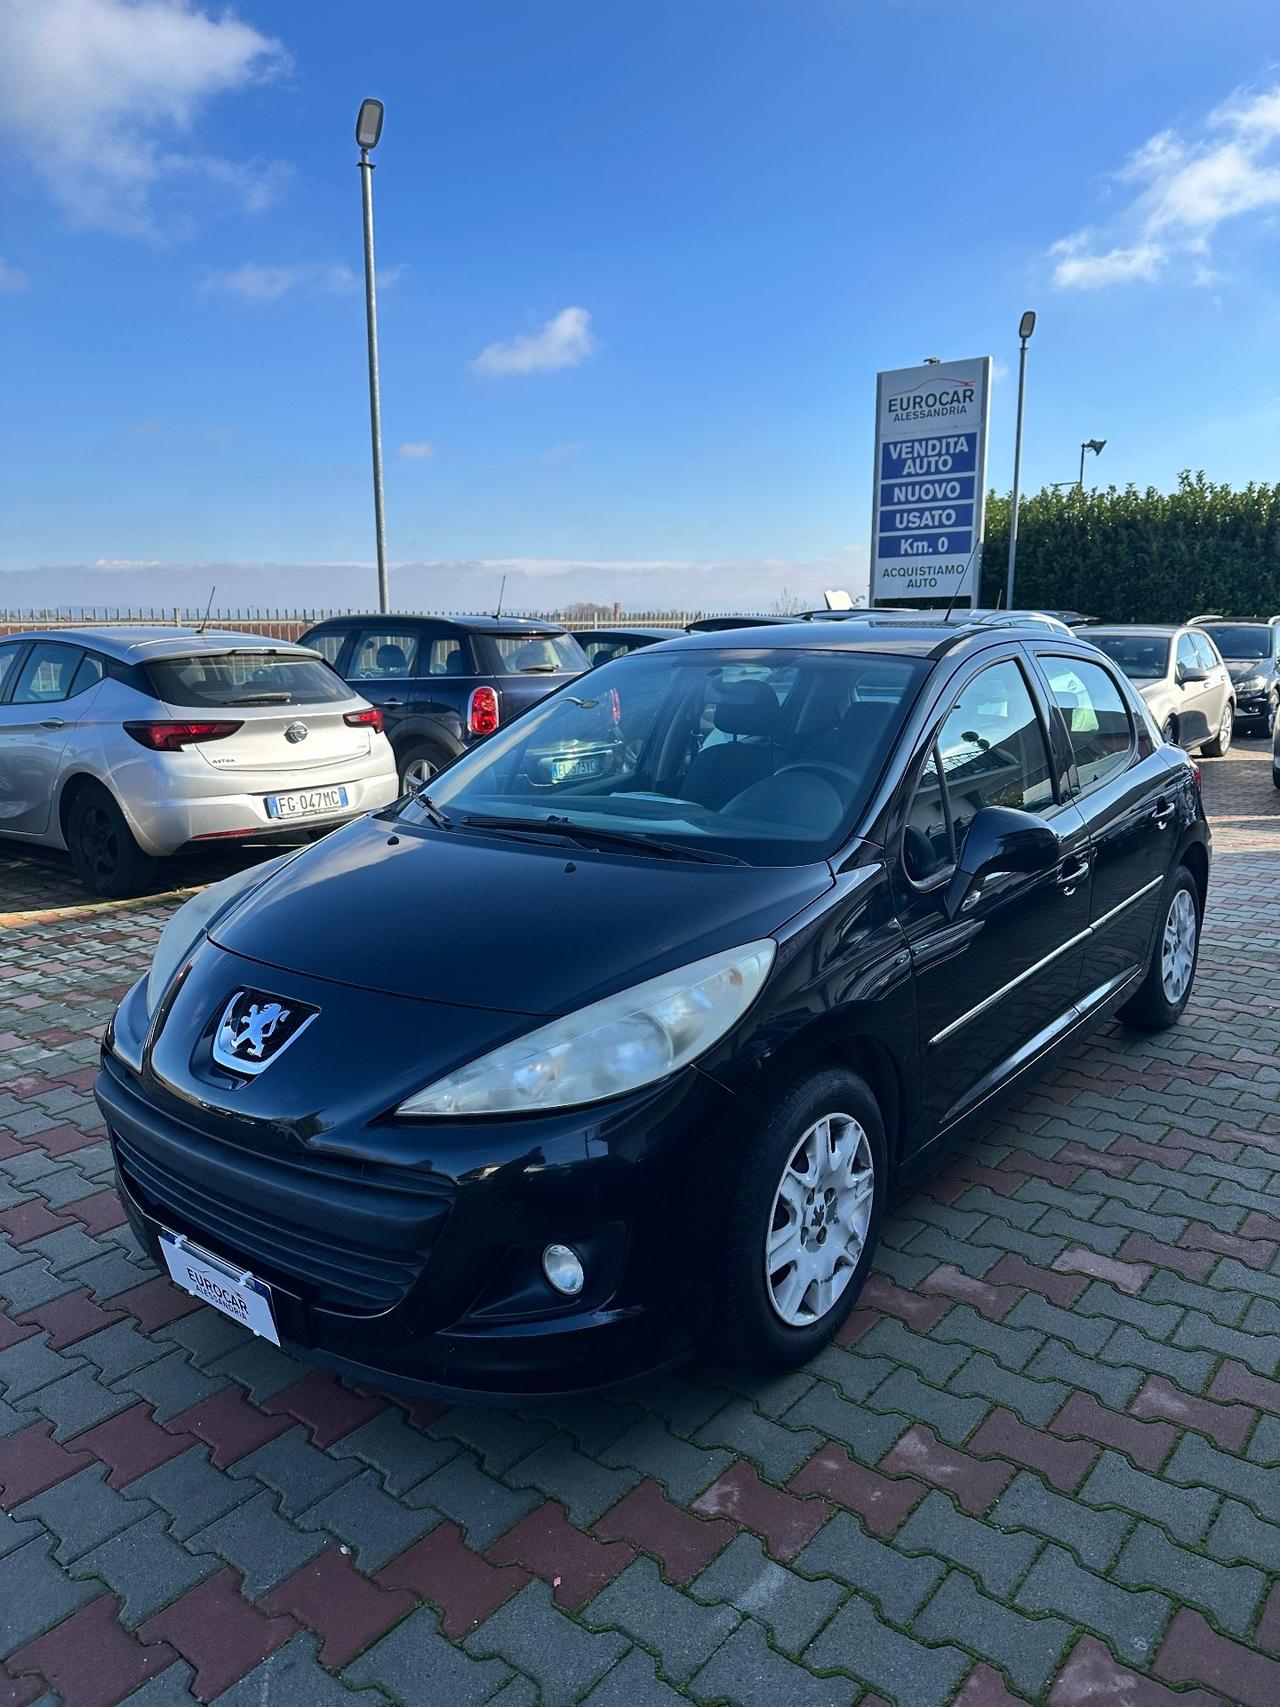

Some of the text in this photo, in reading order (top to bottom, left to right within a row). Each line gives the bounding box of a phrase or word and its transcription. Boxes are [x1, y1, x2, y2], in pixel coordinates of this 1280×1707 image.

[888, 388, 975, 413] EUROCAR
[893, 405, 967, 422] ALESSANDRIA
[889, 436, 969, 460] VENDITA
[902, 454, 953, 475] AUTO
[893, 481, 960, 502] NUOVO
[895, 508, 956, 528] USATO
[900, 536, 948, 555] Km. 0
[882, 564, 965, 578] ACQUISTIAMO
[907, 578, 937, 589] AUTO
[278, 790, 339, 813] FG 047MC
[186, 1267, 249, 1314] EUROCAR
[195, 1286, 248, 1321] ALESSANDRIA
